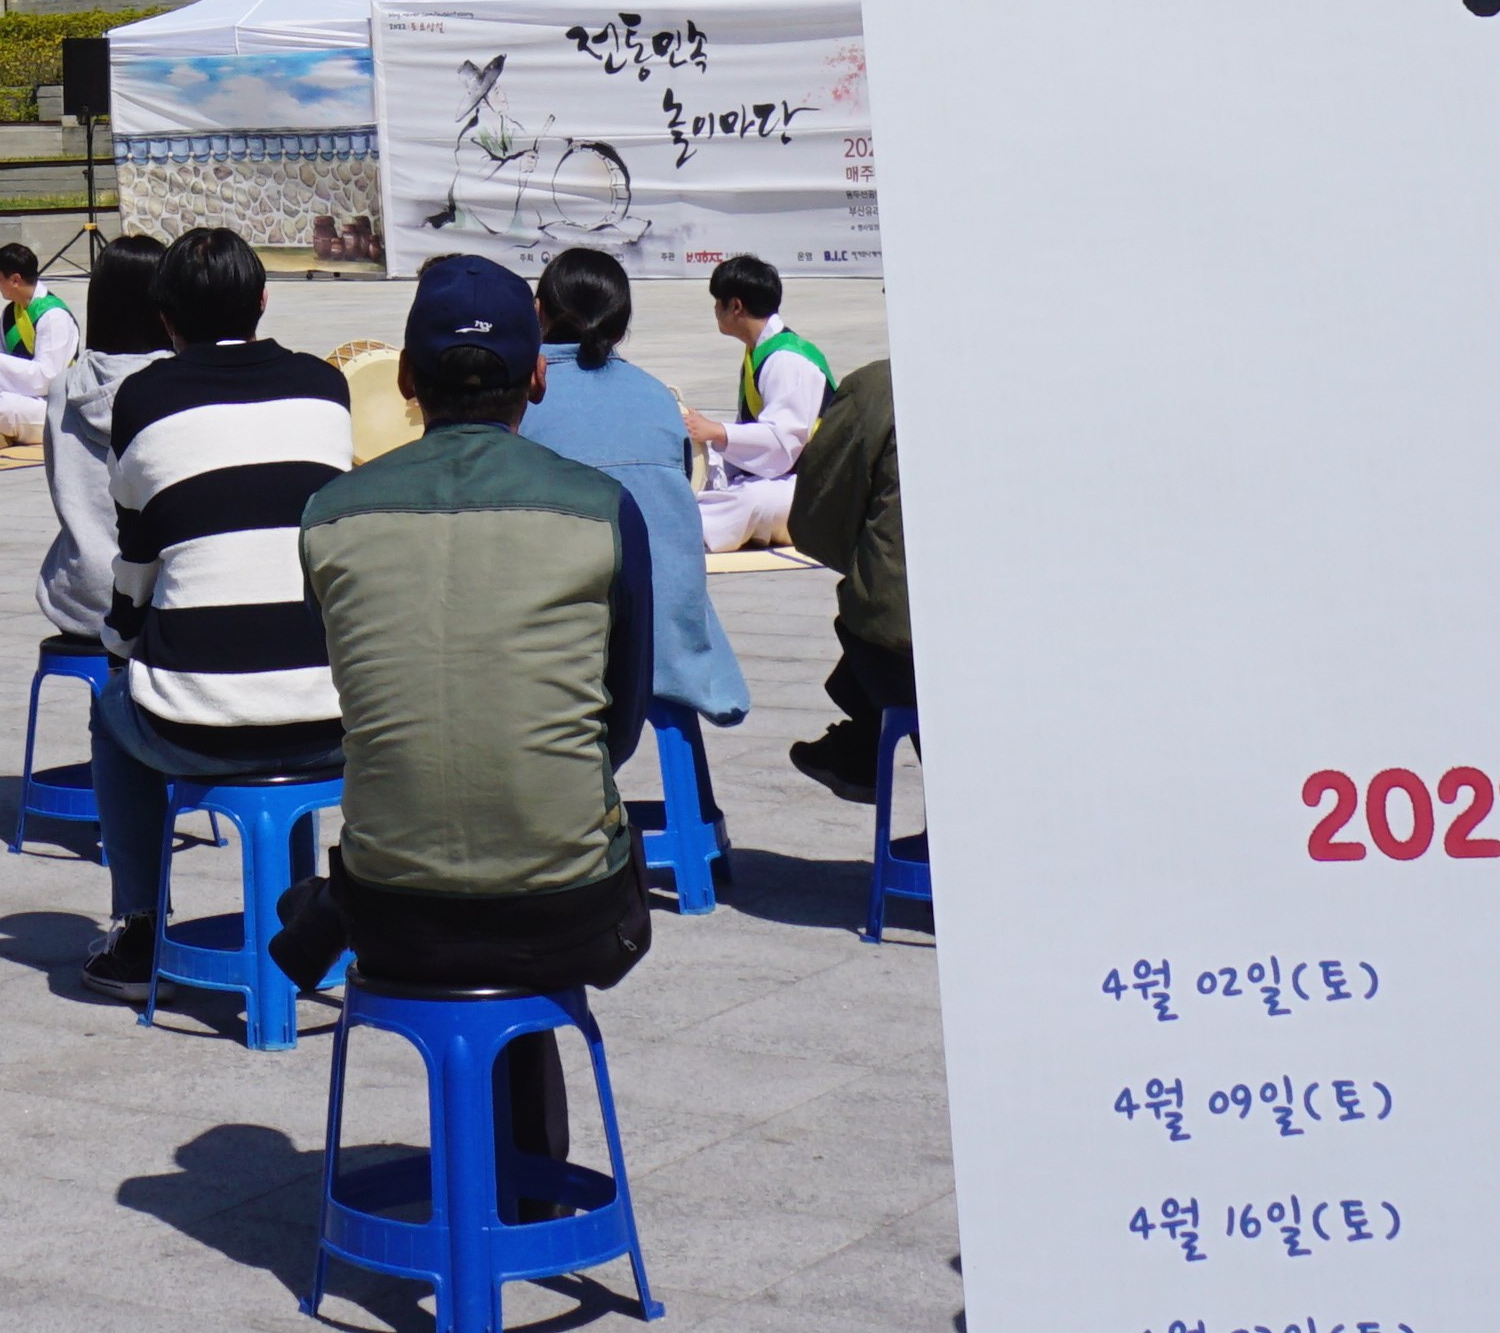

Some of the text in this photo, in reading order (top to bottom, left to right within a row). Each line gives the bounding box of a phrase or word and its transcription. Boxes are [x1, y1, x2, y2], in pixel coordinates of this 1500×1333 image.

[663, 88, 821, 169] 놀이마당
[1101, 958, 1179, 1023] 4월
[1196, 957, 1381, 1018] 02일(토)
[1113, 1078, 1192, 1143] 4월
[1207, 1075, 1394, 1138] 09일(토)
[1128, 1197, 1208, 1263] 4월
[1225, 1195, 1402, 1259] 16일(토)
